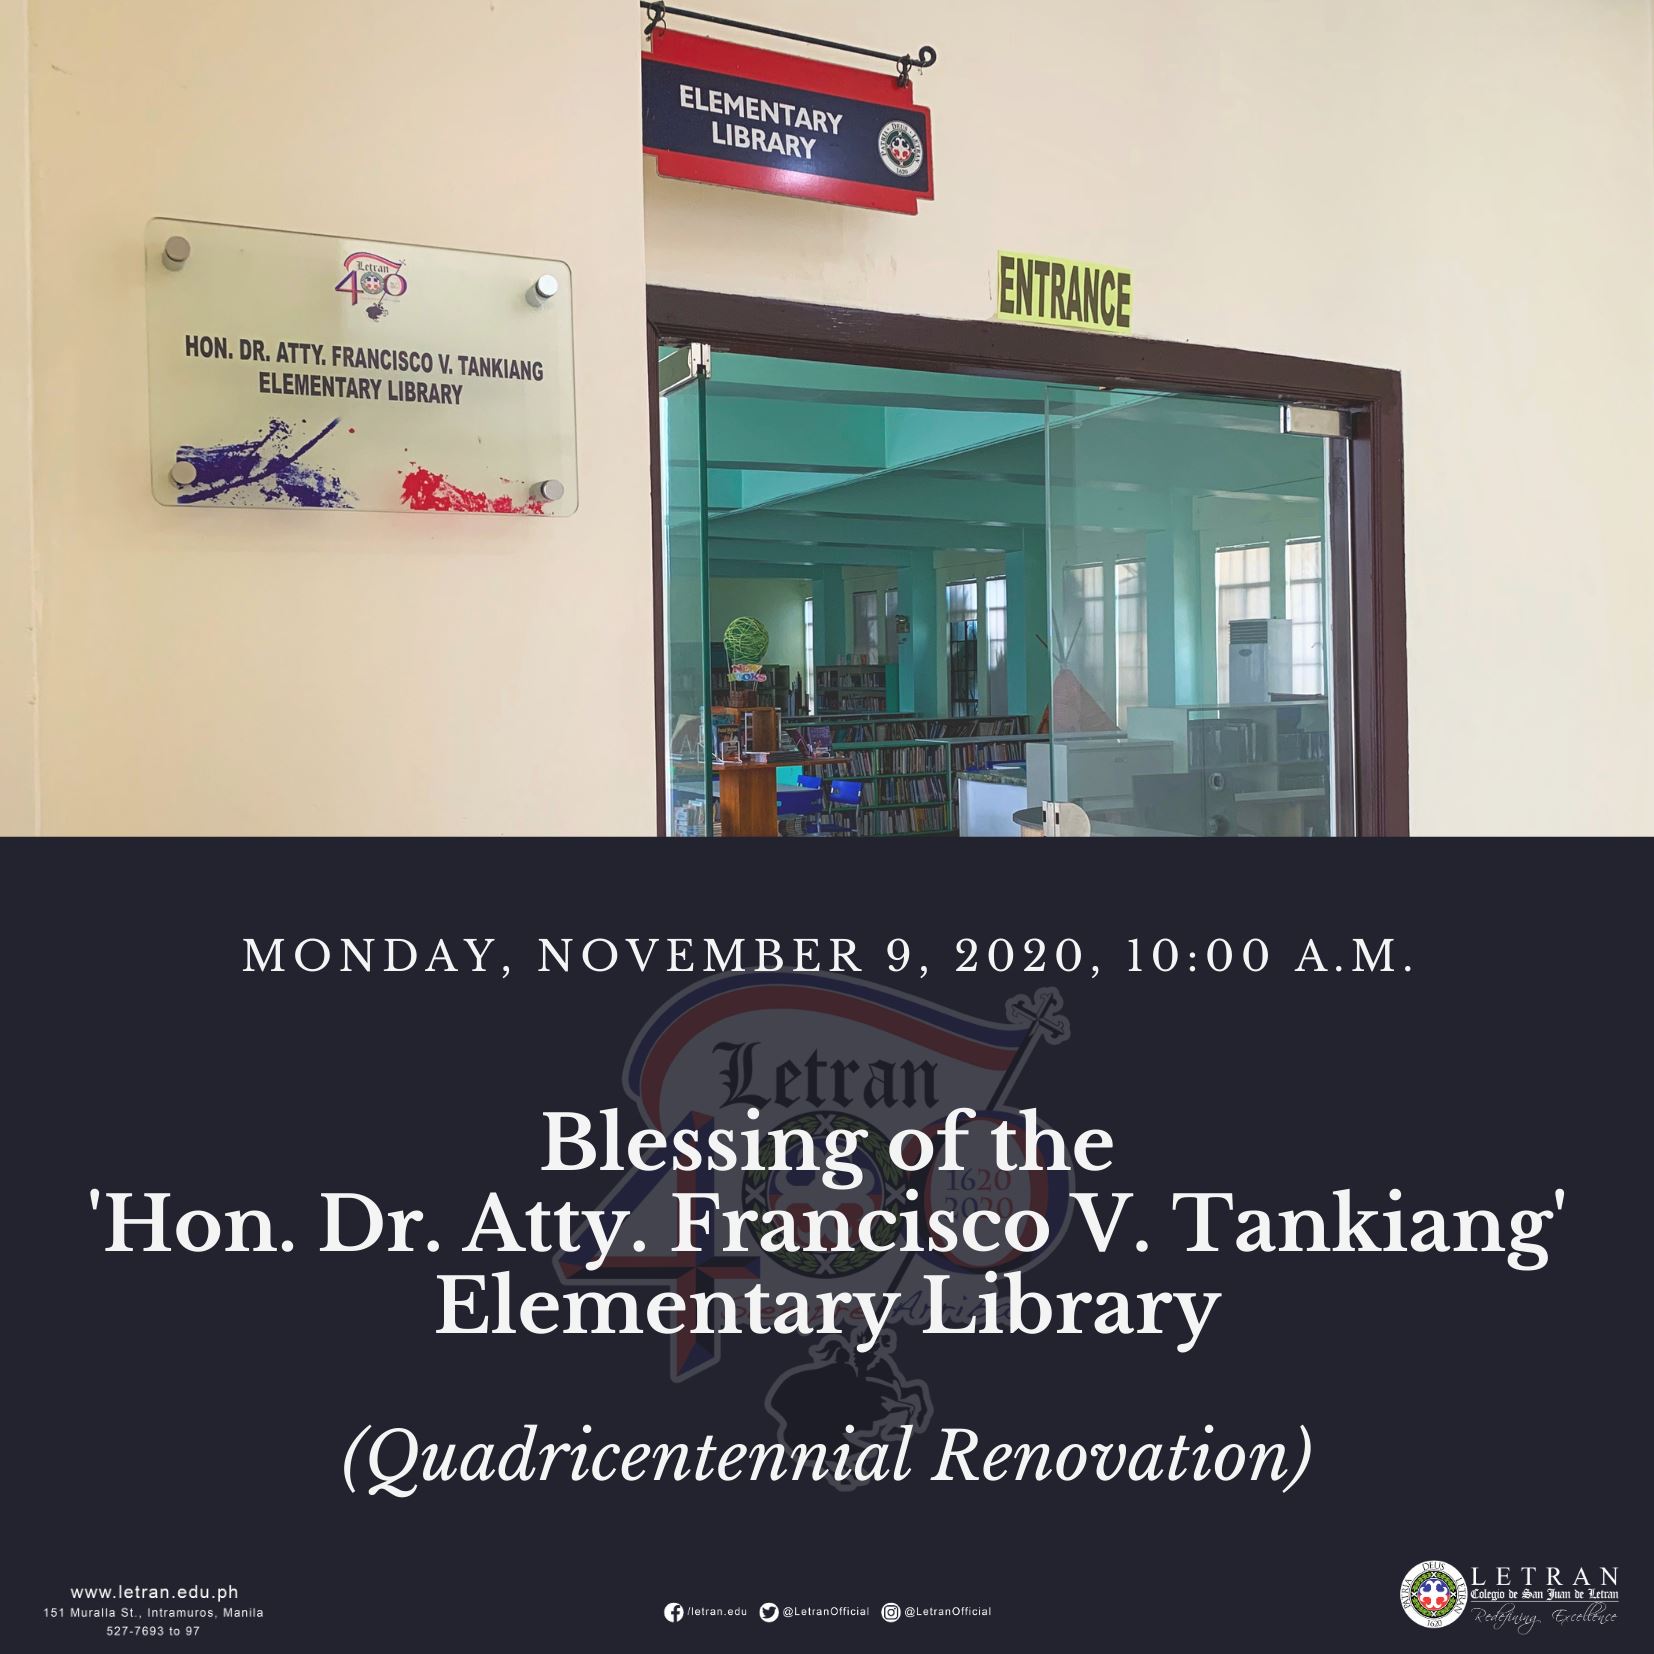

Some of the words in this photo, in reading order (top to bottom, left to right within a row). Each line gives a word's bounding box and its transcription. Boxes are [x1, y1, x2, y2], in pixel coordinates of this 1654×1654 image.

[680, 84, 843, 135] ELEMENTARY
[712, 121, 817, 159] LIBRARY
[356, 261, 389, 273] Letran
[1000, 255, 1131, 328] ENTRANCE
[185, 335, 233, 359] HON.
[239, 339, 270, 362] DR.
[276, 341, 326, 366] ATTY.
[332, 345, 433, 373] FRANCISCO
[438, 354, 453, 375] V.
[458, 355, 544, 382] TANKIANG
[259, 371, 382, 400] ELEMENTARY
[388, 380, 463, 405] LIBRARY
